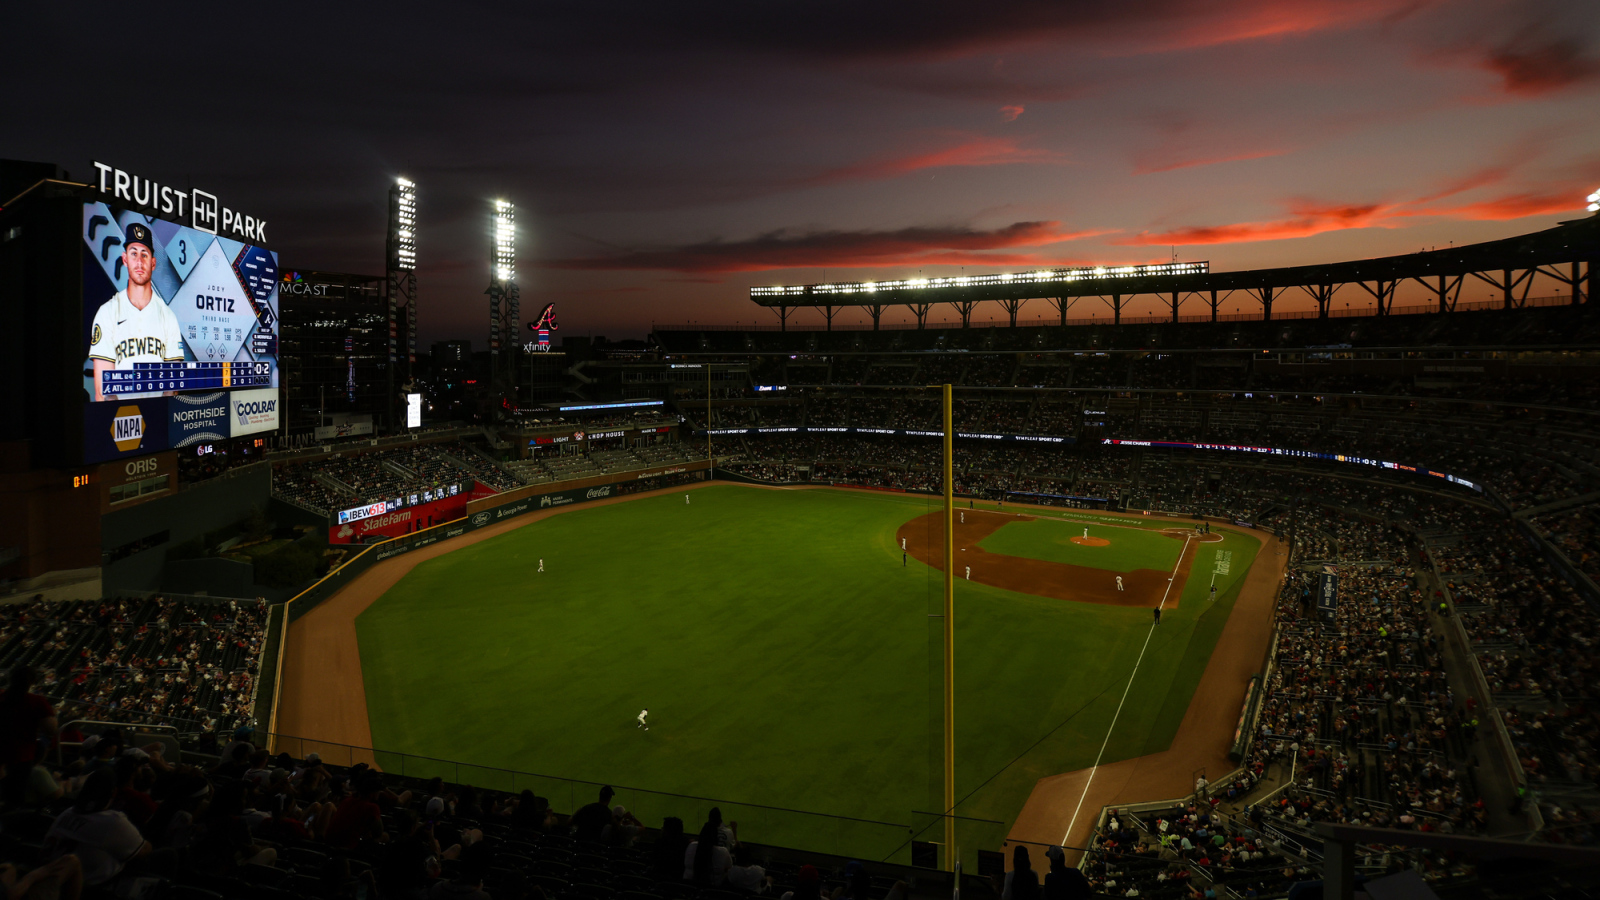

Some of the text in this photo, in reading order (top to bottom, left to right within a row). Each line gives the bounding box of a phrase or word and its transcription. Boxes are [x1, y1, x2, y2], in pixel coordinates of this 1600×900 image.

[94, 161, 267, 243] TRUIST PARK
[178, 239, 187, 265] 3
[196, 294, 235, 313] ORTIZ
[524, 341, 551, 353] xfinity
[264, 363, 270, 374] 2
[112, 384, 124, 392] ATL
[237, 400, 276, 416] COOLRAY
[173, 407, 226, 423] NORTHSIDE
[116, 418, 141, 439] NAPA
[183, 420, 217, 431] HOSPITAL
[588, 430, 625, 440] CHOP HOUSE
[205, 445, 213, 454] LG
[125, 457, 157, 476] ORIS
[587, 486, 611, 499] Coca-Cola
[387, 502, 395, 510] NL
[503, 504, 528, 516] Georgia Power
